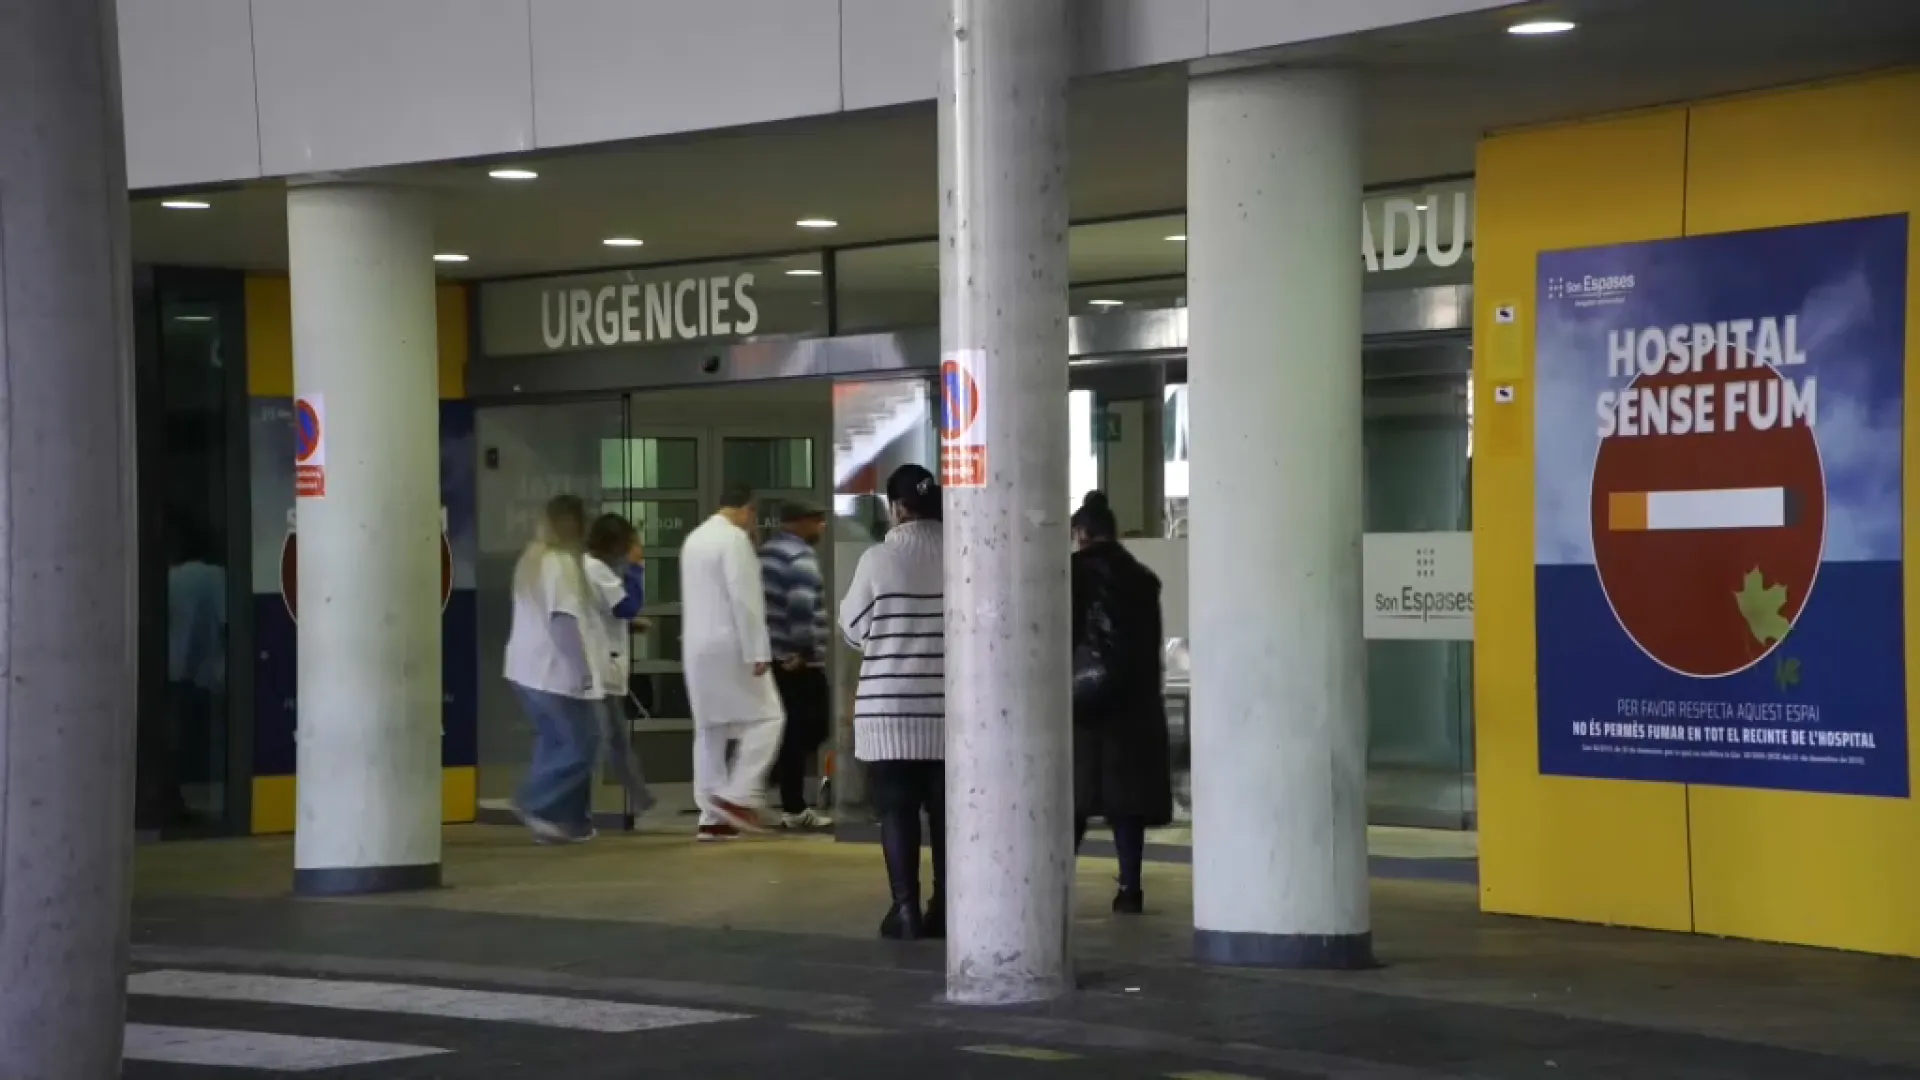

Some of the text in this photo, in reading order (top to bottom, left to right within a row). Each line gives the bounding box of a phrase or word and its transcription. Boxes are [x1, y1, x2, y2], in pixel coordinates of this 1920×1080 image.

[1584, 274, 1635, 298] Espases
[541, 270, 758, 349] URGÈNCIES
[1608, 314, 1806, 378] HOSPITAL
[1597, 375, 1818, 438] SENSE FUM
[1375, 585, 1475, 623] Son Espases
[1618, 699, 1820, 723] PER FAVOR RESPECTA AQUEST ESPAI
[1572, 720, 1587, 736] NO
[1648, 724, 1685, 740] FUMAR
[1688, 726, 1702, 742] EN
[1704, 727, 1725, 743] TOT
[1727, 727, 1740, 743] EL
[1742, 727, 1788, 745] RECINTE
[1791, 729, 1806, 745] DE
[1808, 730, 1876, 749] L'HOSPITAL
